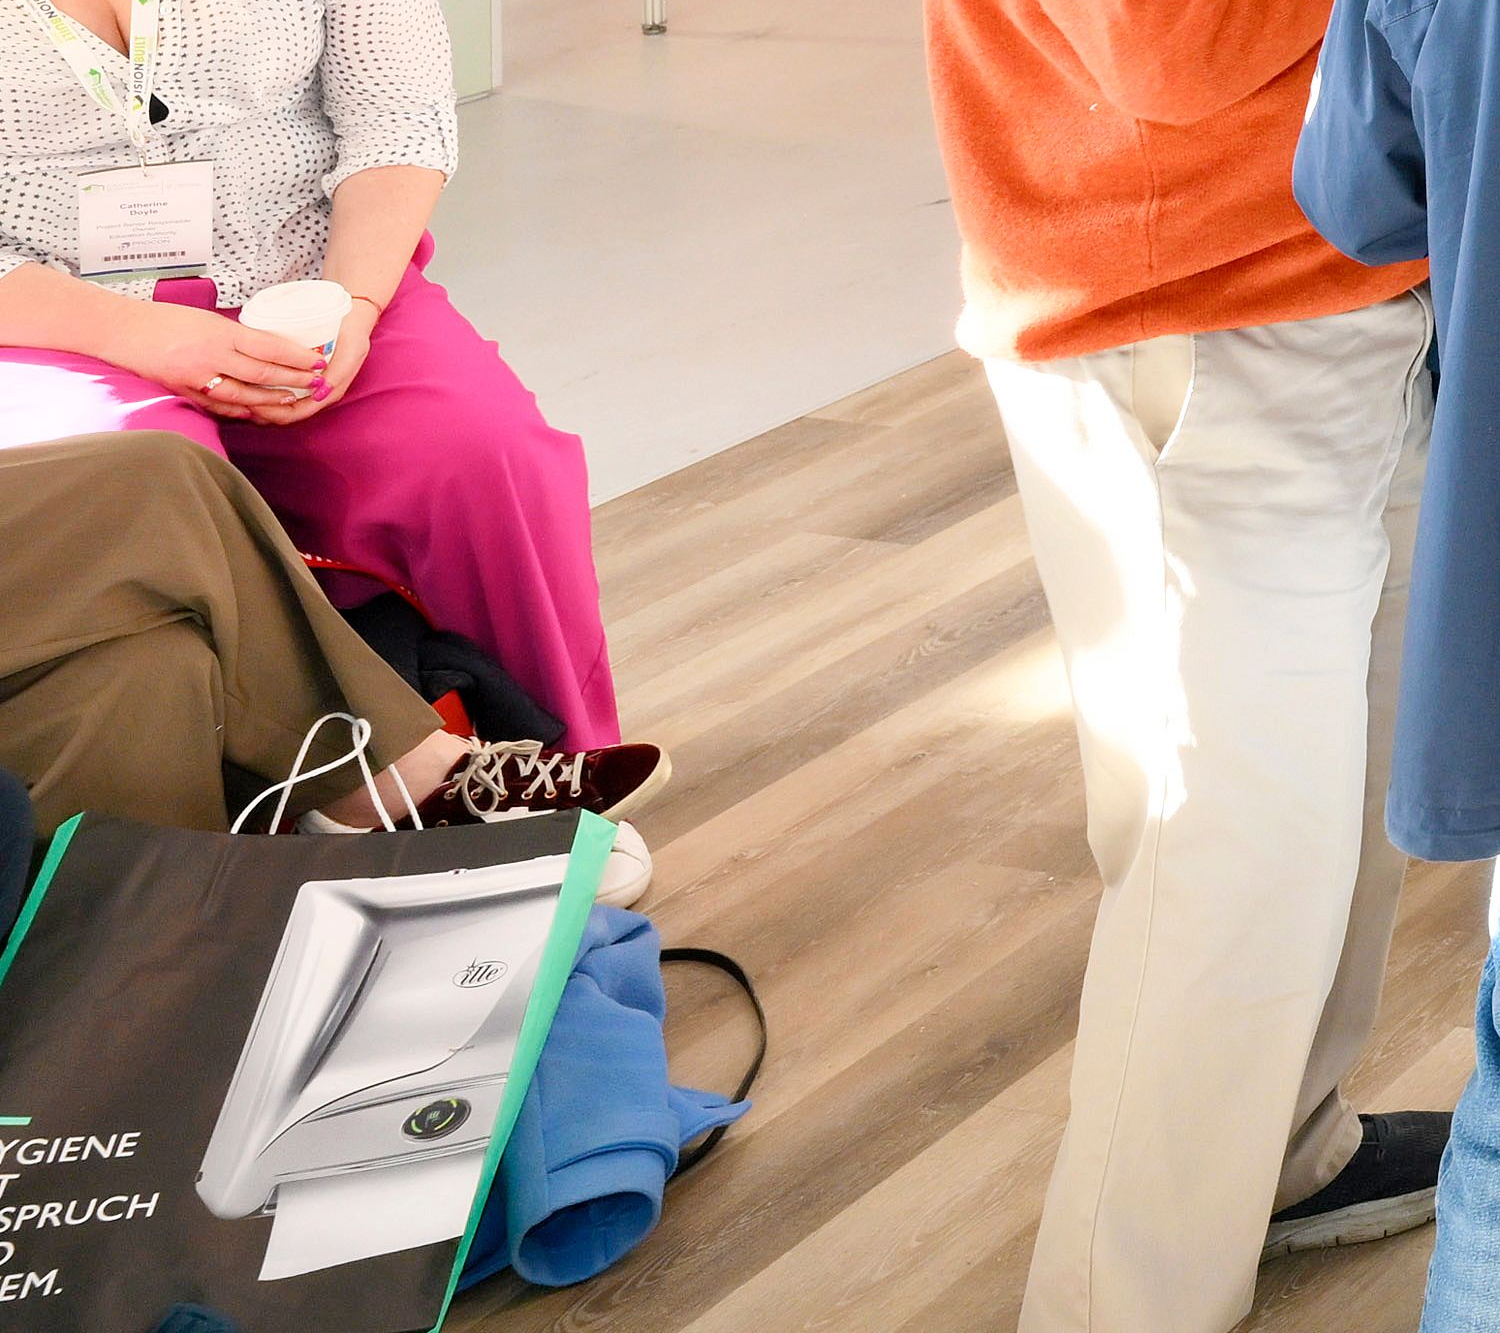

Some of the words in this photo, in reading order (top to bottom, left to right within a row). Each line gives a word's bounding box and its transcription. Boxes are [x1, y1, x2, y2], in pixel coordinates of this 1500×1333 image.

[131, 35, 147, 112] VISIONBUILT
[119, 200, 168, 210] Catherine
[129, 208, 158, 216] Doyle
[460, 963, 499, 985] ille
[0, 1132, 142, 1166] YGIENE
[0, 1192, 160, 1234] SPRUCH
